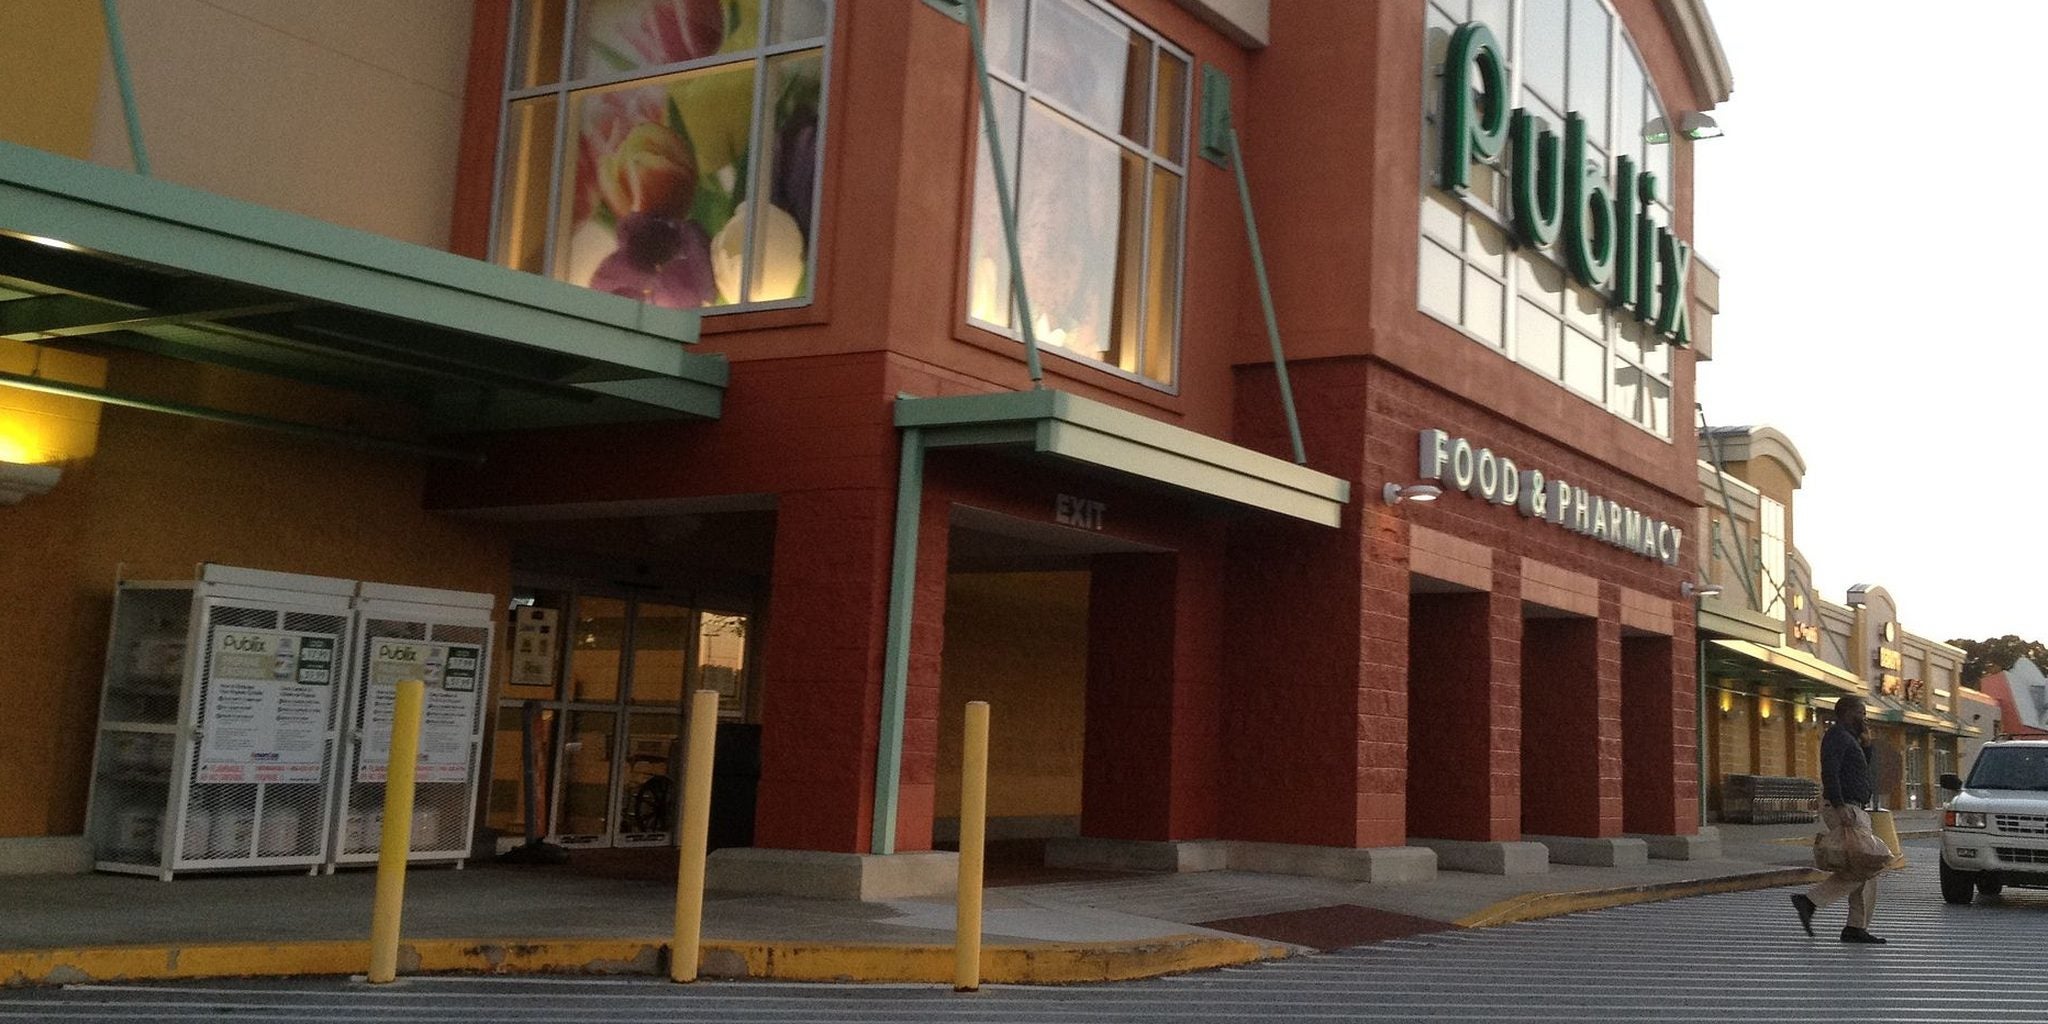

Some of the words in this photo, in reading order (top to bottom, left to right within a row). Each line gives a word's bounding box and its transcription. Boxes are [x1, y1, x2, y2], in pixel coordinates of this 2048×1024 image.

[1442, 20, 1691, 346] Publix
[1056, 493, 1105, 530] EXIT
[1421, 428, 1520, 505] FOOD
[1523, 469, 1547, 518] &
[1547, 479, 1683, 566] PHARMACY
[223, 634, 267, 653] Publix
[379, 645, 417, 662] Publix
